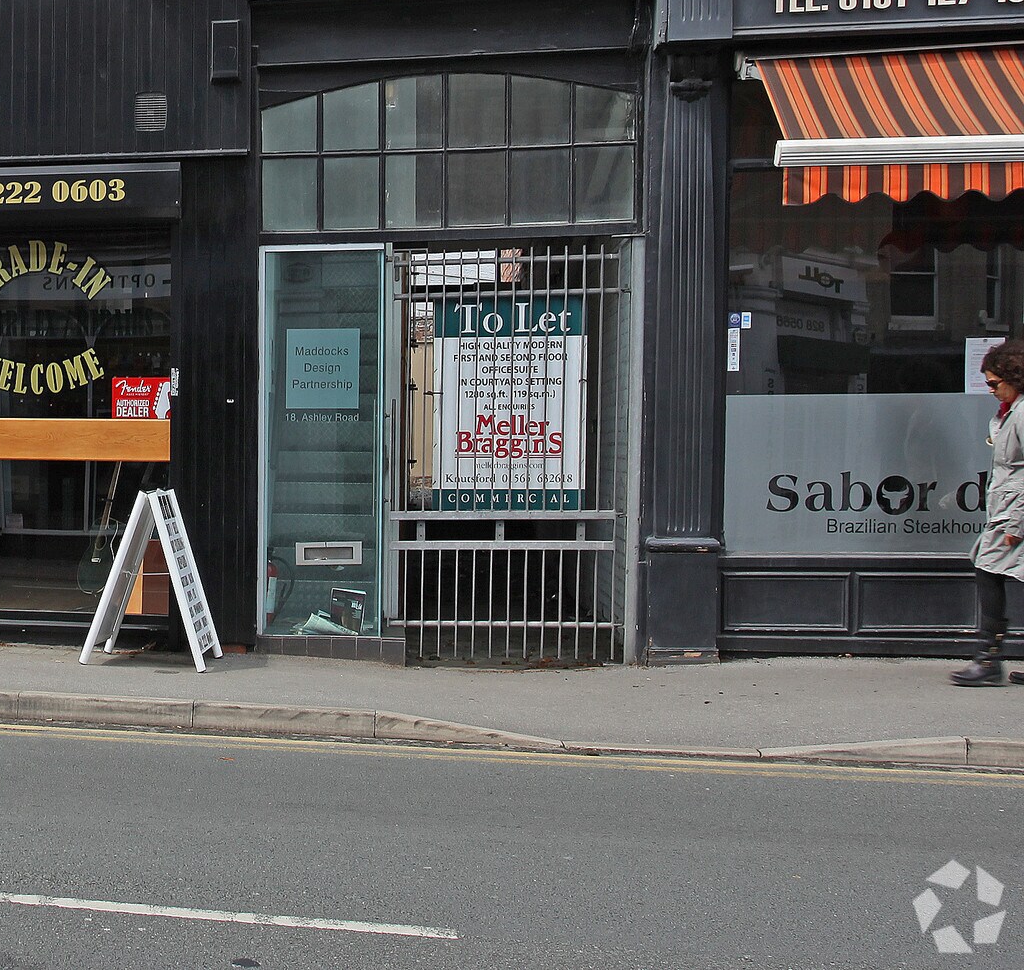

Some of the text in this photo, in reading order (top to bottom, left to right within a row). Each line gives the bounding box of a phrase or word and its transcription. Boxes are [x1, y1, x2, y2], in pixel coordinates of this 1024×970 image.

[51, 179, 126, 203] 0603
[453, 302, 572, 334] To Let
[460, 341, 481, 350] HIGH
[523, 340, 563, 349] MODERN
[295, 346, 349, 356] Maddocks
[453, 354, 477, 362] FRST
[479, 353, 498, 362] AND
[500, 353, 536, 362] SECOND
[304, 363, 341, 375] Design
[482, 365, 512, 374] OFFICE
[292, 379, 353, 391] Partnership
[469, 378, 522, 386] COURTYARD
[525, 377, 562, 386] SETTING
[115, 380, 151, 396] Fender
[511, 390, 526, 398] 119
[116, 399, 150, 407] AUTHORIZED
[498, 403, 536, 411] ENQUIRIS
[116, 407, 149, 417] DEALER
[286, 412, 360, 424] 18, Ashley Road
[477, 415, 550, 437] Meller
[445, 473, 496, 484] Knutsford
[502, 474, 531, 484] 0565
[448, 493, 570, 504] COMMERCAL
[766, 470, 987, 516] Sabor d
[826, 517, 989, 534] Brazilian Steakhous
